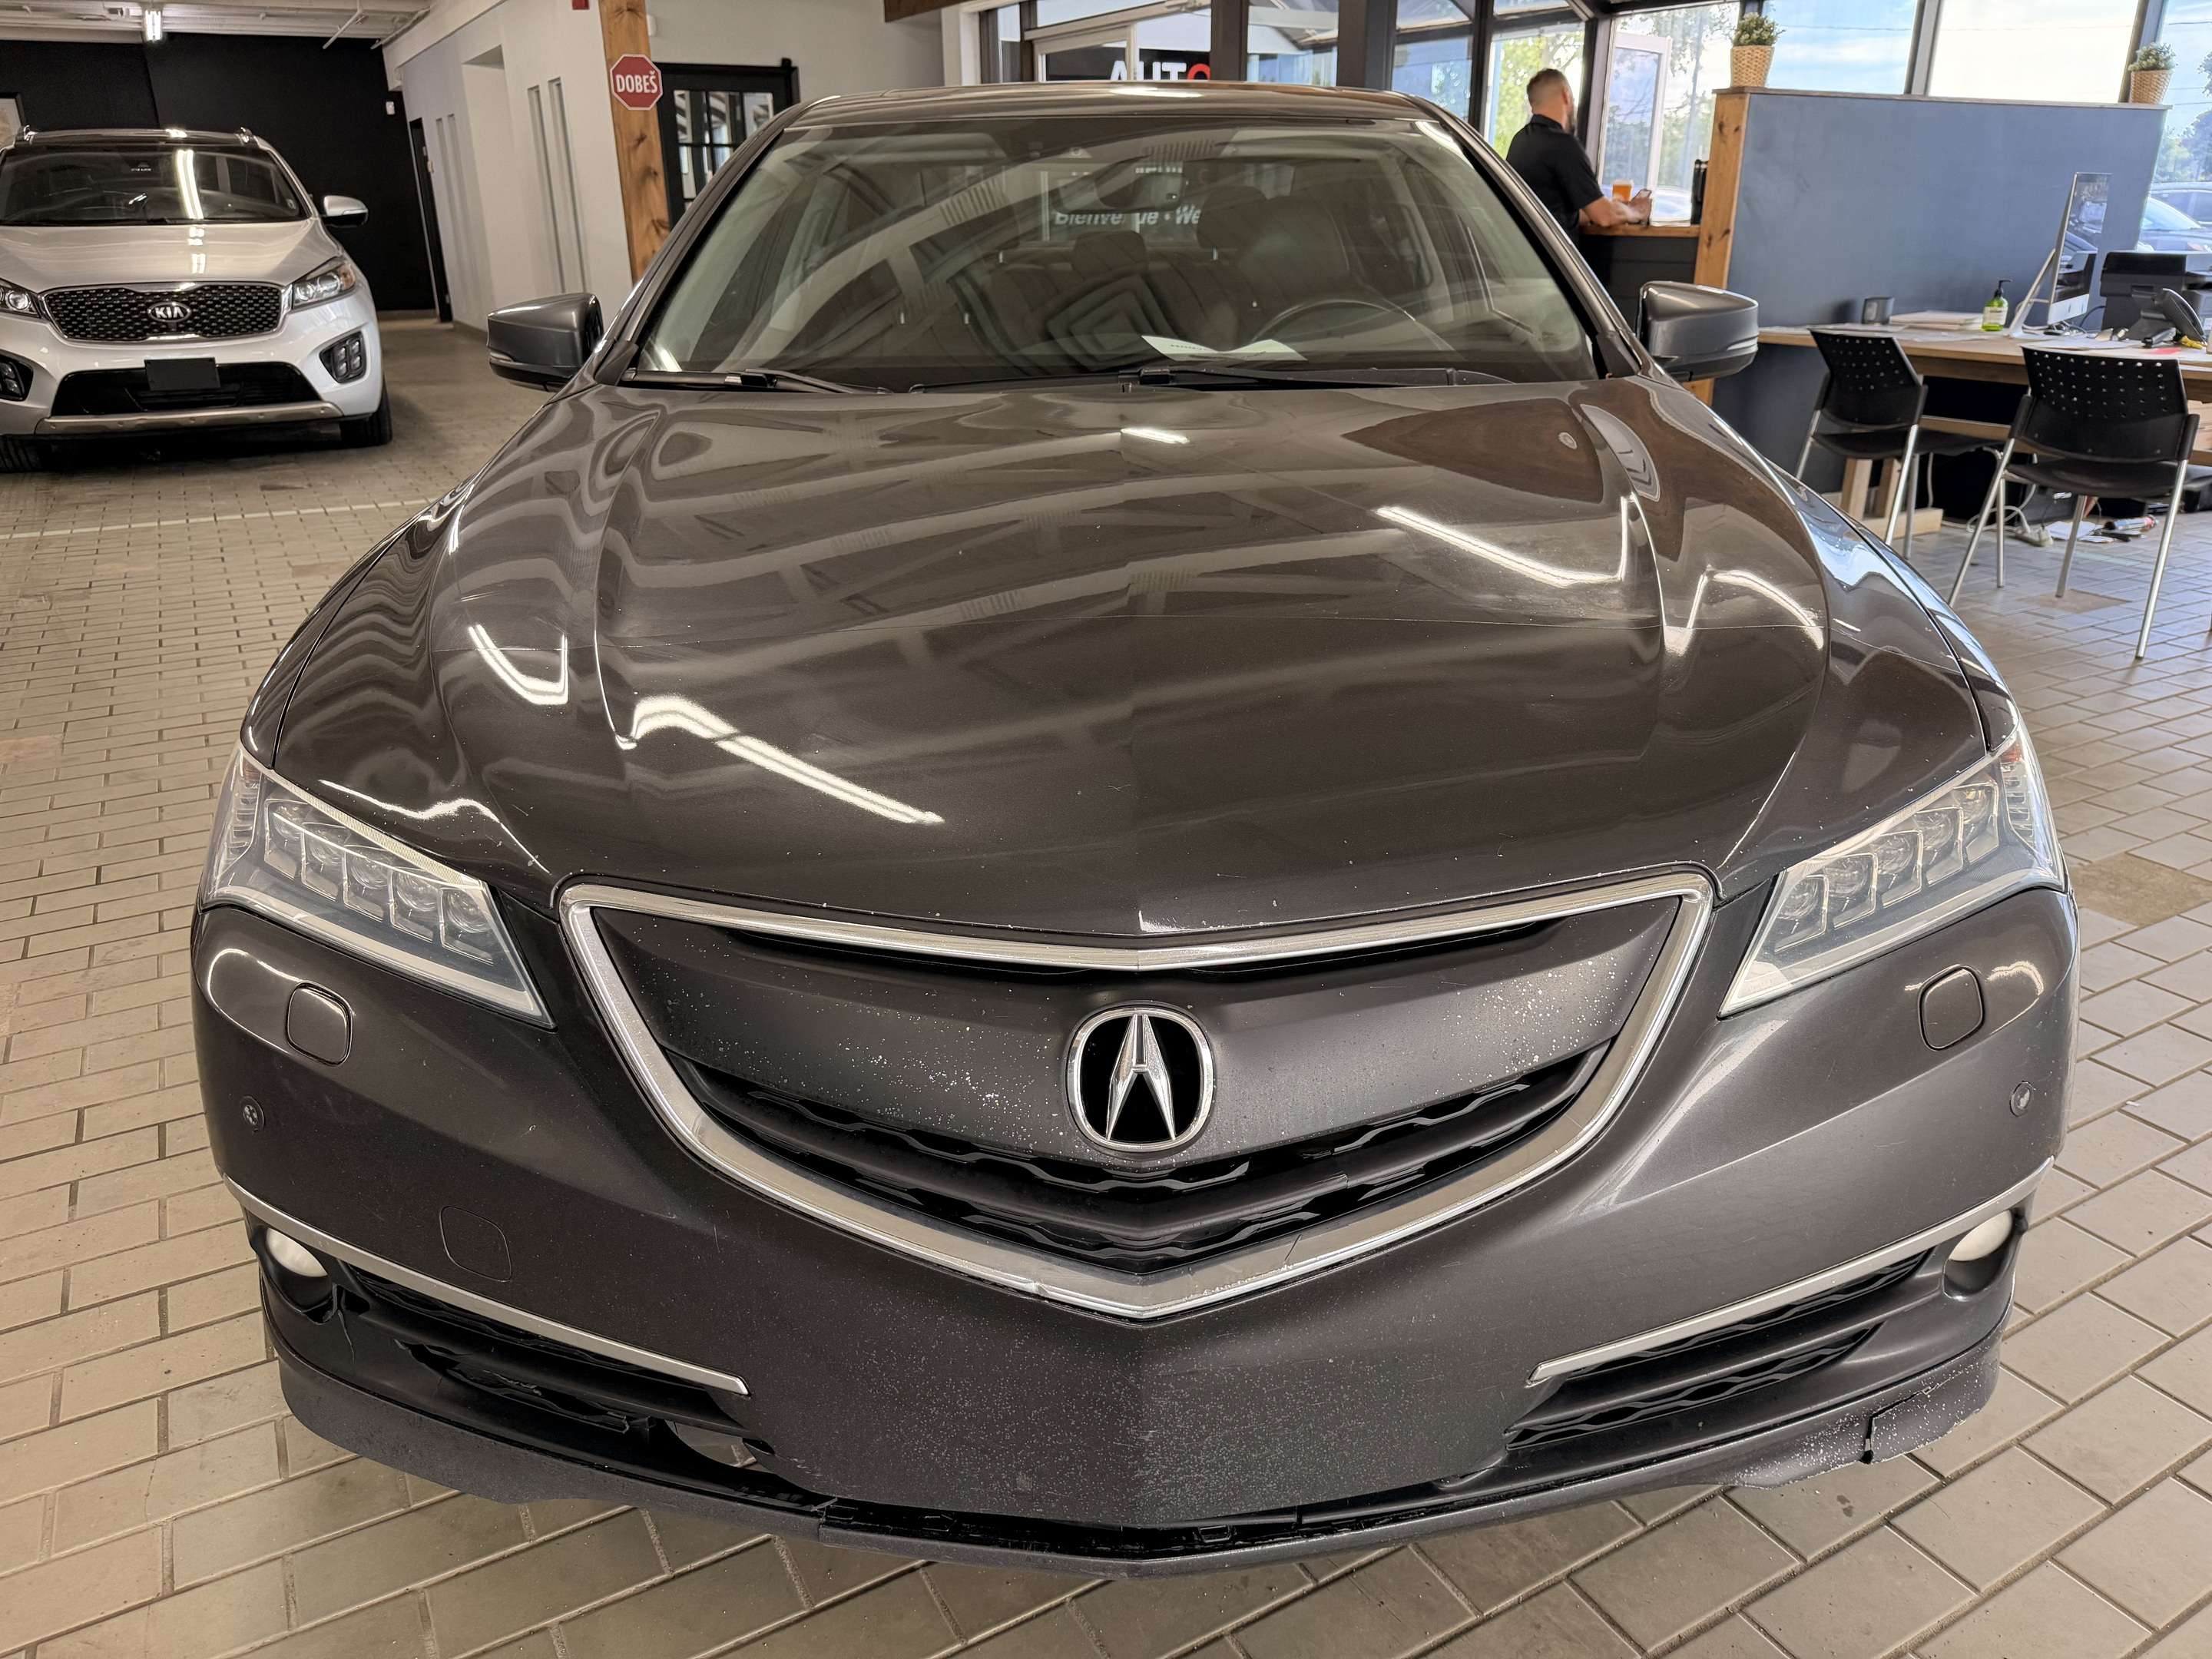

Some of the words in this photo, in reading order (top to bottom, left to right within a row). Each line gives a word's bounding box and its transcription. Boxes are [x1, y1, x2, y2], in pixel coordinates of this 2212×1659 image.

[615, 70, 658, 94] DOBEŠ
[1055, 211, 1158, 225] Bienveue
[154, 306, 184, 319] KIA
